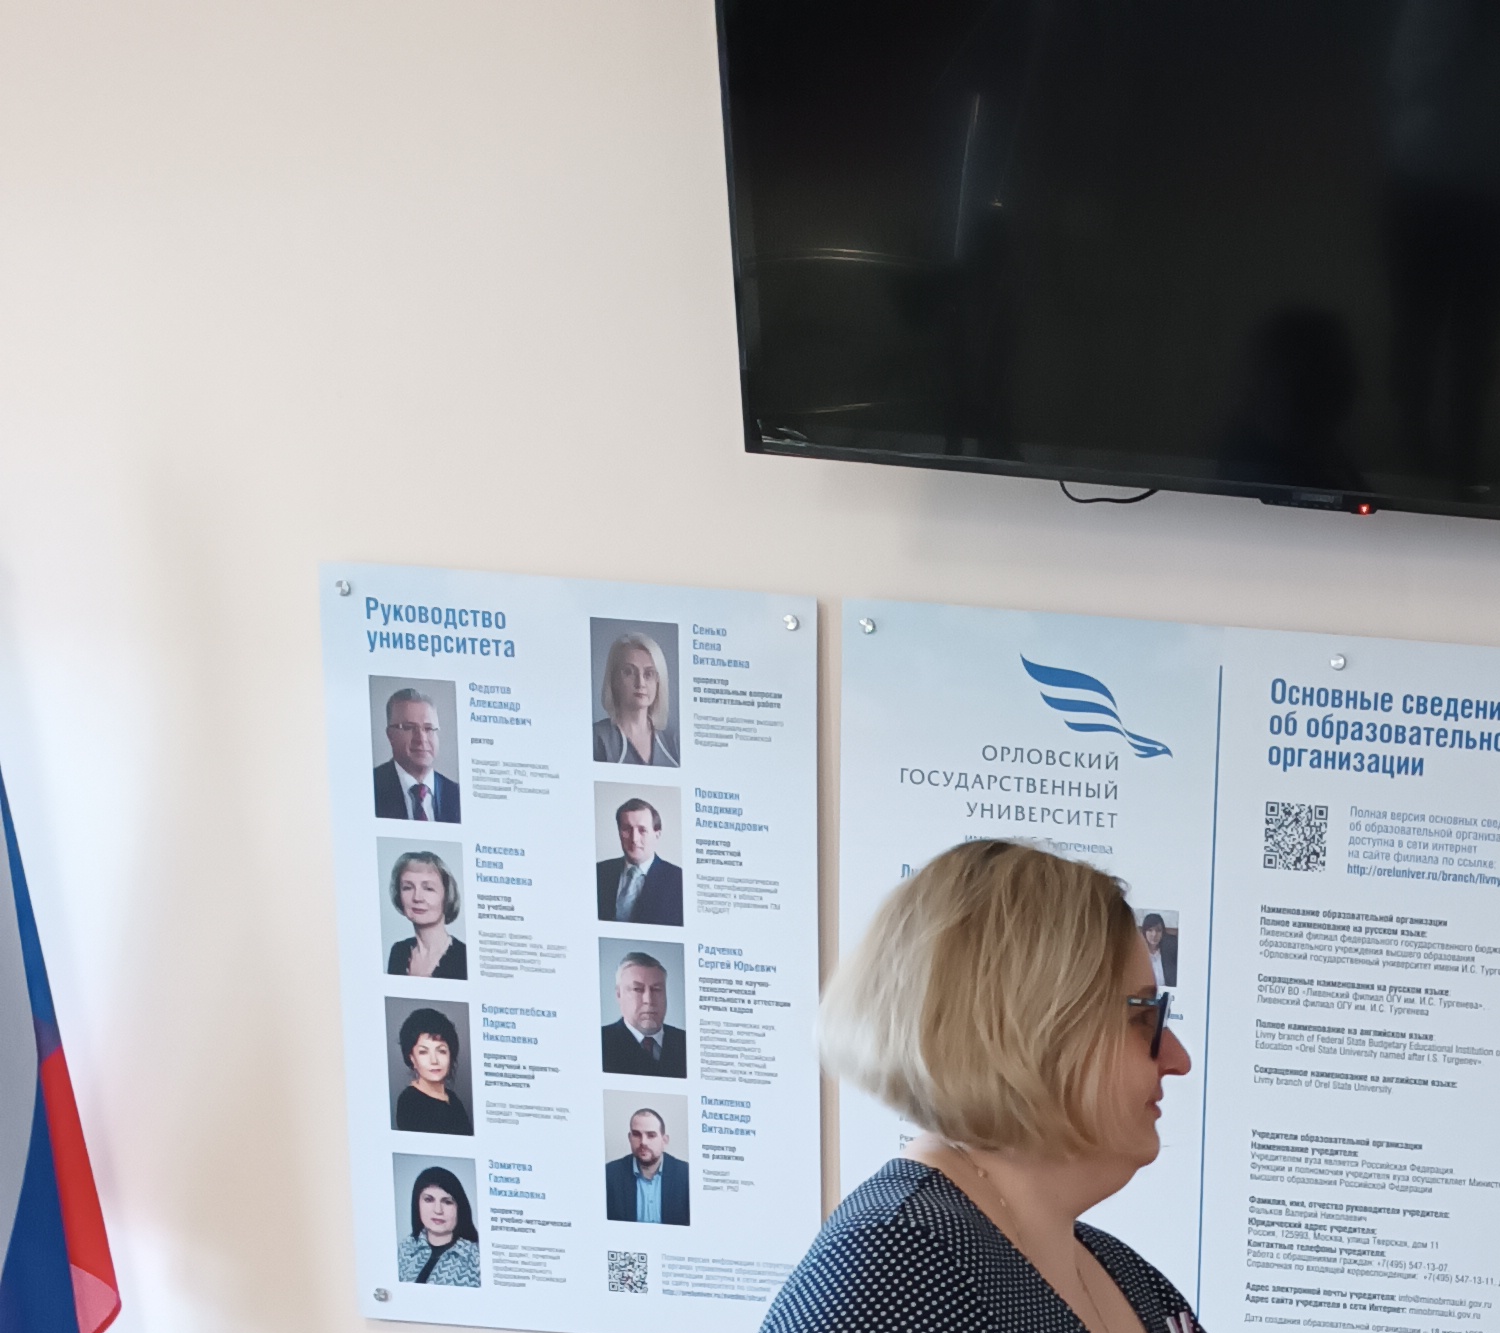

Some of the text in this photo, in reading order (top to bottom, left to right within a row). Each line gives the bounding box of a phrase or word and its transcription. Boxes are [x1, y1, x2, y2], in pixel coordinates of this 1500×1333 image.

[365, 597, 506, 629] Руководство
[692, 625, 727, 636] Сенько
[367, 630, 515, 657] университета
[692, 640, 721, 651] Елена
[692, 655, 749, 668] Витальевна
[468, 683, 511, 694] Федотов
[1271, 679, 1393, 712] Основные
[469, 698, 520, 712] Александр
[470, 713, 531, 725] Анатольевич
[1270, 711, 1297, 736] об
[982, 745, 1118, 770] ОРЛОВСКИЙ
[1268, 747, 1424, 777] организации
[900, 768, 1117, 799] ГОСУДАРСТВЕННЫЙ
[695, 803, 743, 817] Владимир
[966, 802, 1117, 827] УНИВЕРСИТЕТ
[1350, 807, 1387, 820] Полная
[1390, 812, 1425, 824] версия
[1428, 815, 1477, 826] основных
[695, 818, 768, 832] Александрович
[1349, 822, 1361, 832] об
[1364, 823, 1452, 839] образовательной
[475, 844, 525, 856] Алексеева
[1044, 837, 1113, 854] Тургенева
[1348, 837, 1477, 855] доступна в сети интернет
[475, 858, 503, 869] Елена
[1348, 851, 1359, 860] на
[1362, 851, 1390, 862] сайте
[1393, 852, 1439, 865] филиала
[1442, 858, 1454, 866] по
[476, 873, 532, 886] Николаевна
[697, 944, 743, 956] Радченко
[698, 958, 776, 973] Сергей Юрьевич
[482, 1018, 516, 1030] Лариса
[482, 1032, 538, 1044] Николаевна
[701, 1096, 751, 1108] Пилипенко
[701, 1110, 751, 1124] Александр
[701, 1124, 756, 1136] Витальевич
[488, 1173, 520, 1184] Галина
[489, 1187, 545, 1199] Михайловна
